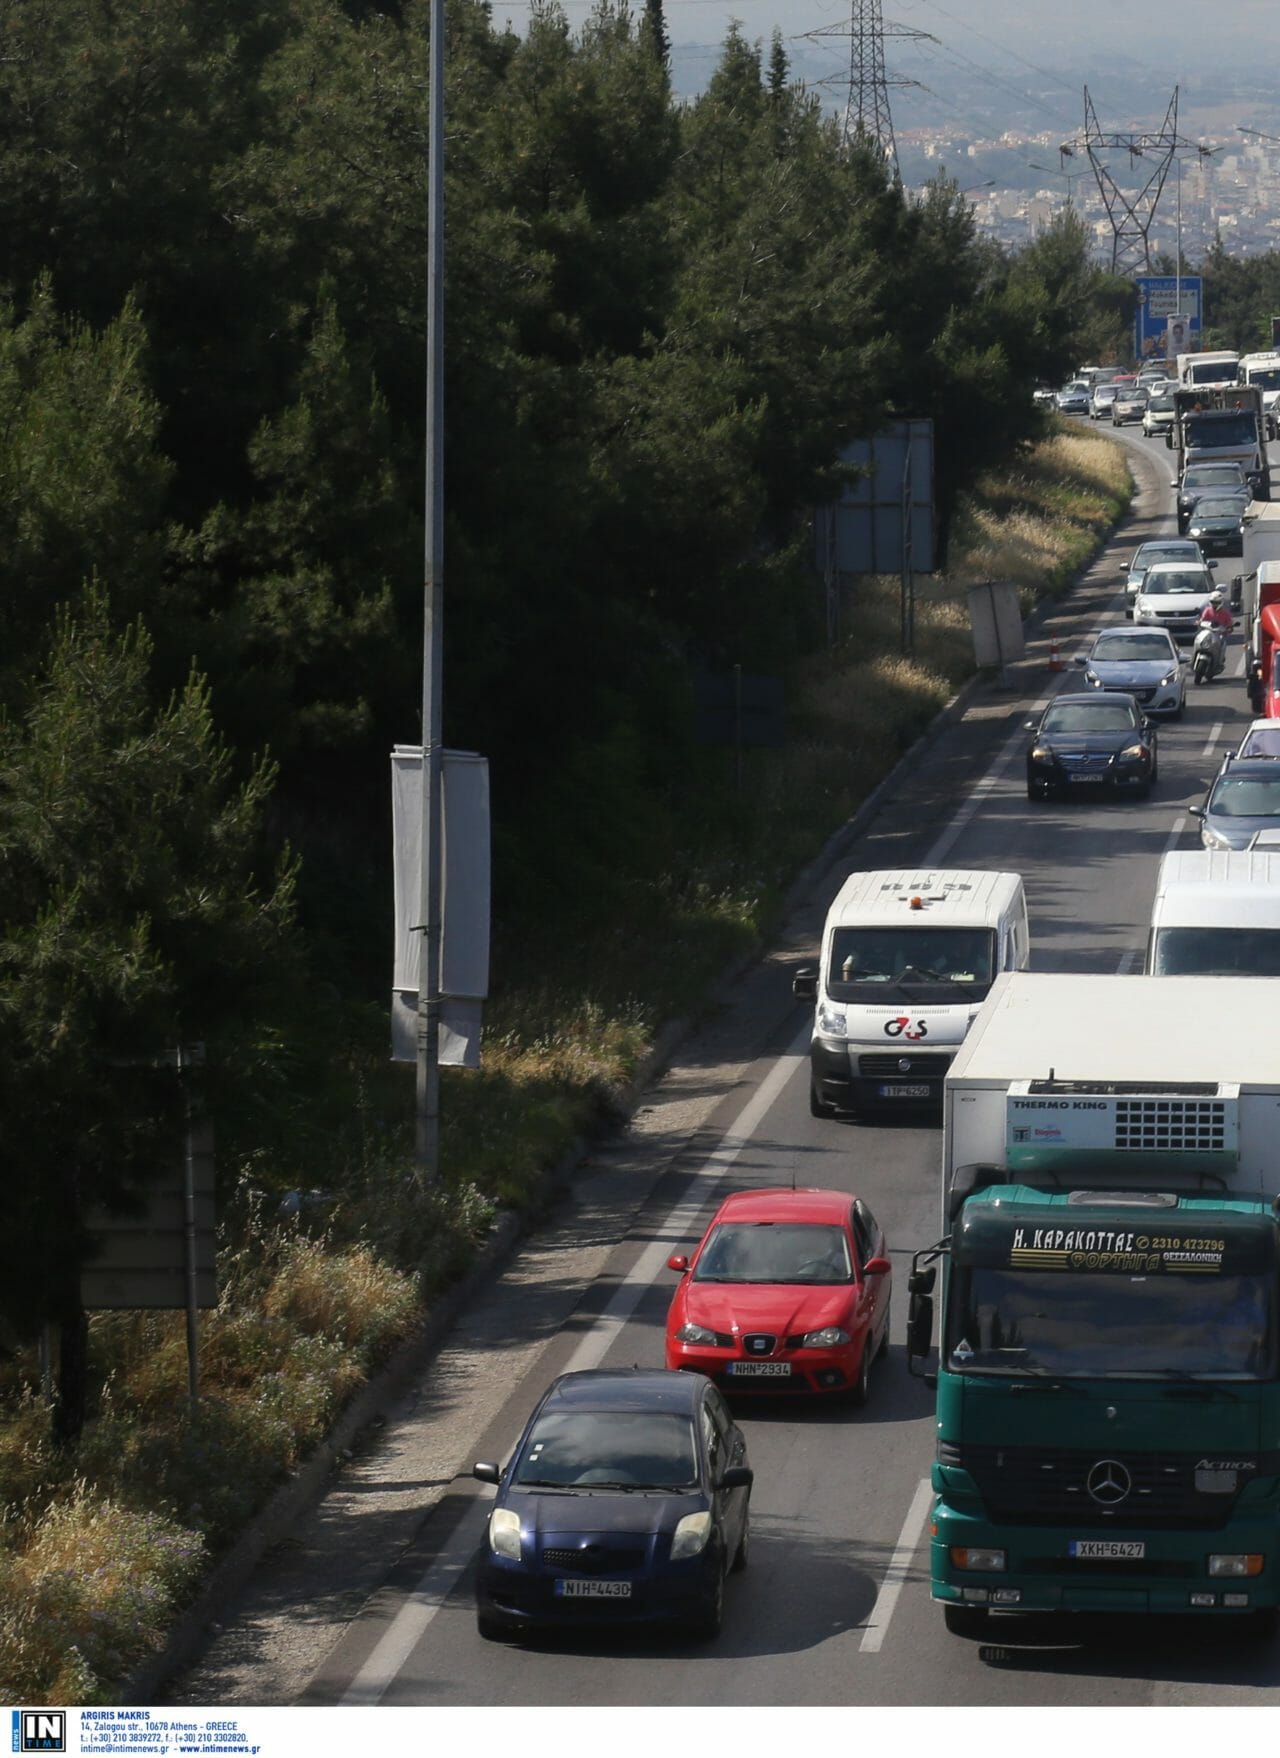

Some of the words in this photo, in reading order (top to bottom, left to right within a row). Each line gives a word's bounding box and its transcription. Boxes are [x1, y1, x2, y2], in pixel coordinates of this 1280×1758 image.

[884, 1017, 928, 1040] G4S
[1014, 1101, 1069, 1109] THERMO
[1073, 1102, 1107, 1110] KING
[1152, 1238, 1180, 1249] 2310
[1183, 1239, 1225, 1250] 473796
[1071, 1252, 1160, 1270] ΦΟΡΤΗΓΑ
[1163, 1252, 1222, 1263] ΘΕΣΣΑΛΟΝΙΚΗ
